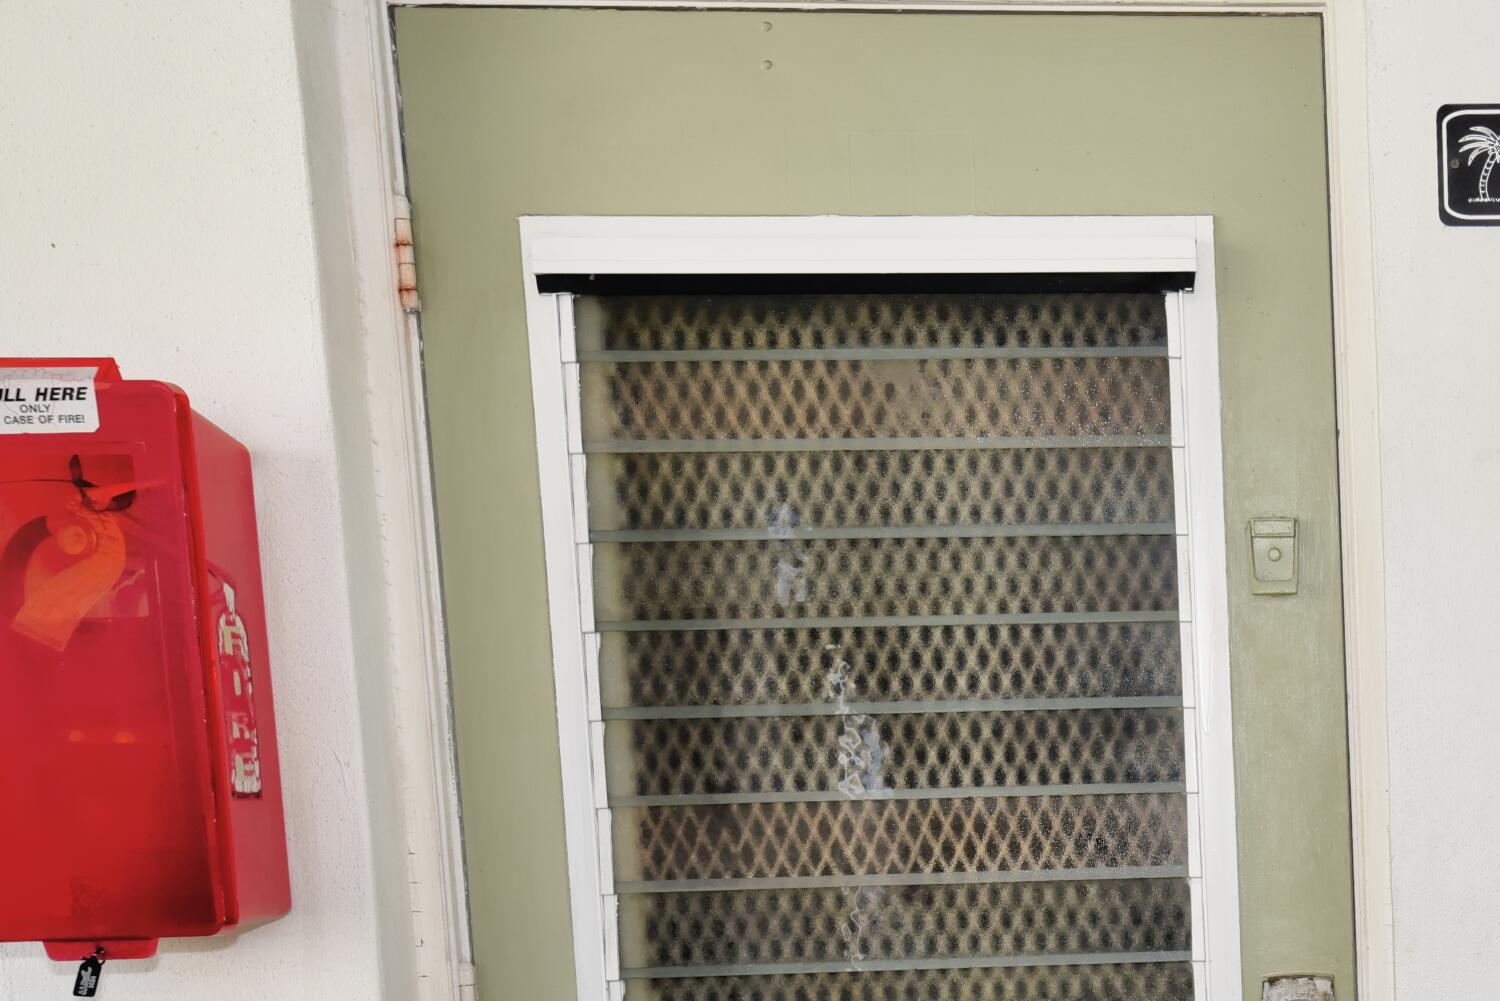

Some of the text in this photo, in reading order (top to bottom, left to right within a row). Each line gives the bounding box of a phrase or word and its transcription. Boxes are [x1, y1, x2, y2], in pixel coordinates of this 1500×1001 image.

[0, 387, 88, 402] LL HERE
[20, 404, 51, 413] ONLY
[4, 414, 85, 424] CASE OF FIRE!
